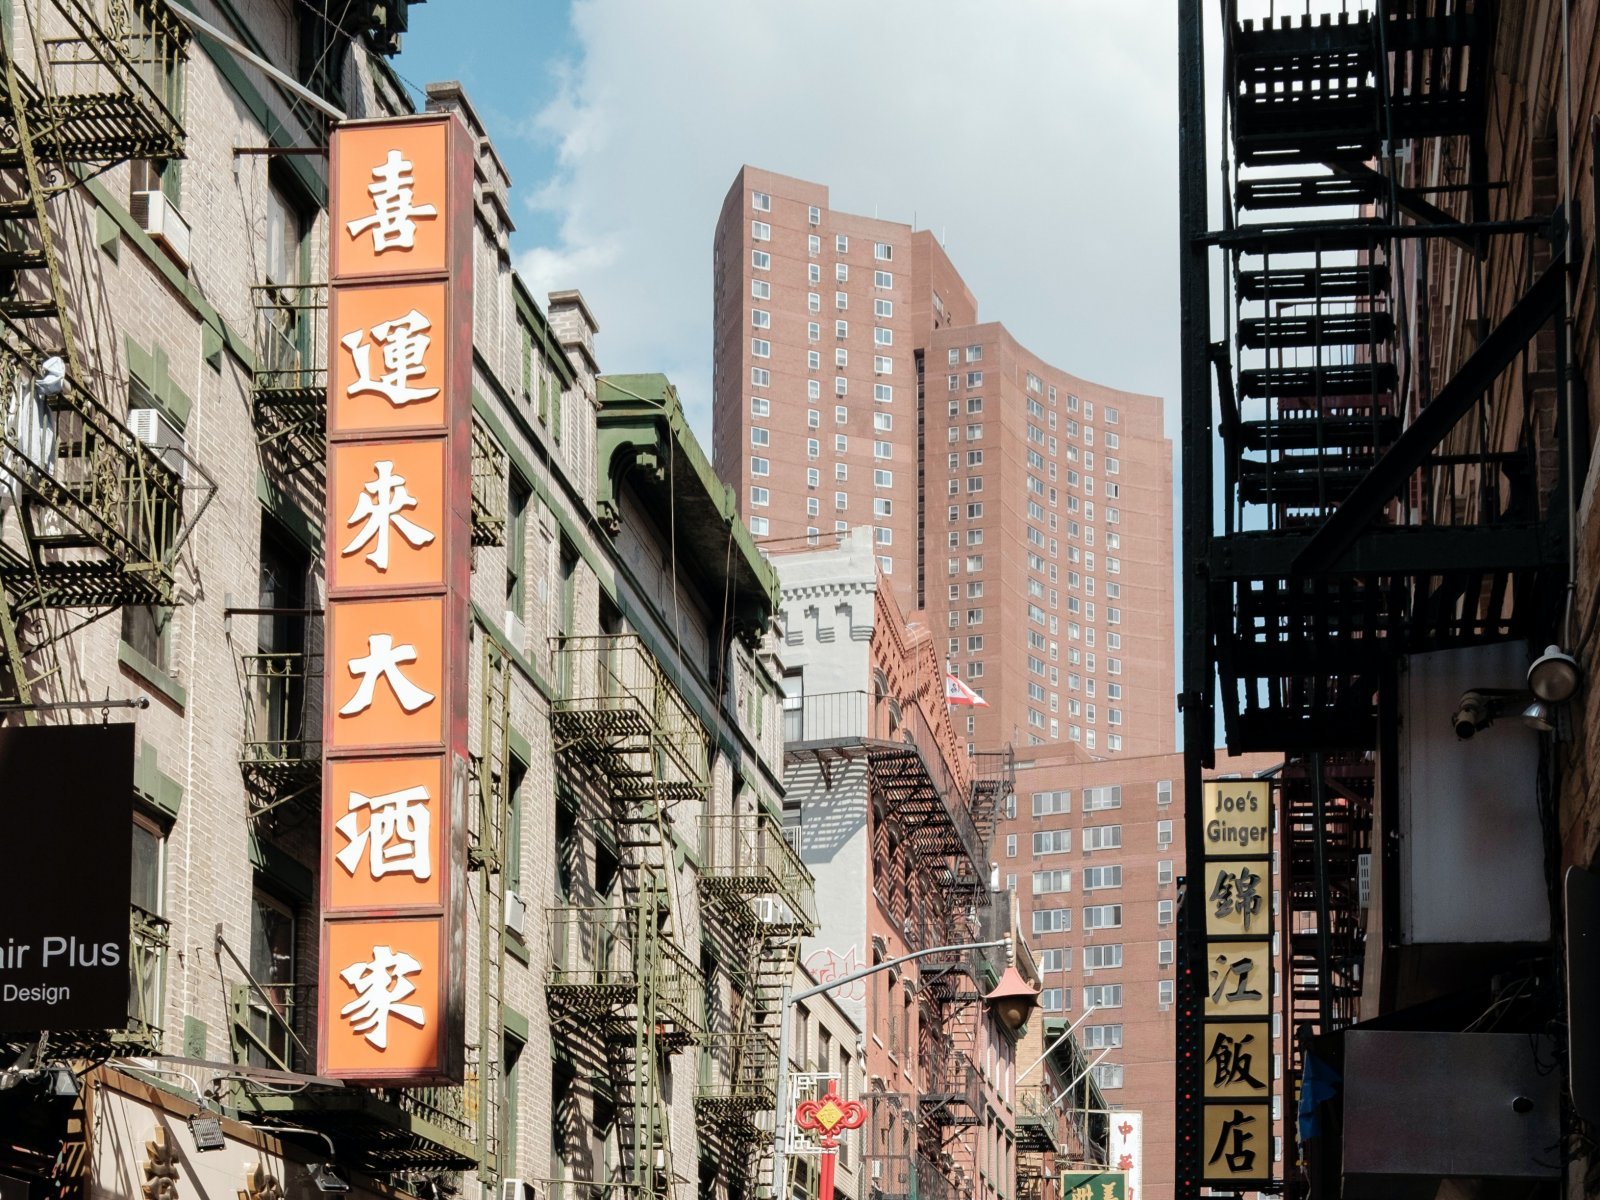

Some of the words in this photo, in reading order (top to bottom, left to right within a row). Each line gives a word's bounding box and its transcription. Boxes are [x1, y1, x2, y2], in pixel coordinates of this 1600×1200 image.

[336, 149, 440, 1049] 喜運來大酒家
[1215, 790, 1258, 813] Joe's
[1207, 818, 1268, 846] Ginger
[42, 936, 120, 968] Plus
[3, 983, 70, 1005] Design
[1206, 867, 1266, 1173] 錦江飯店
